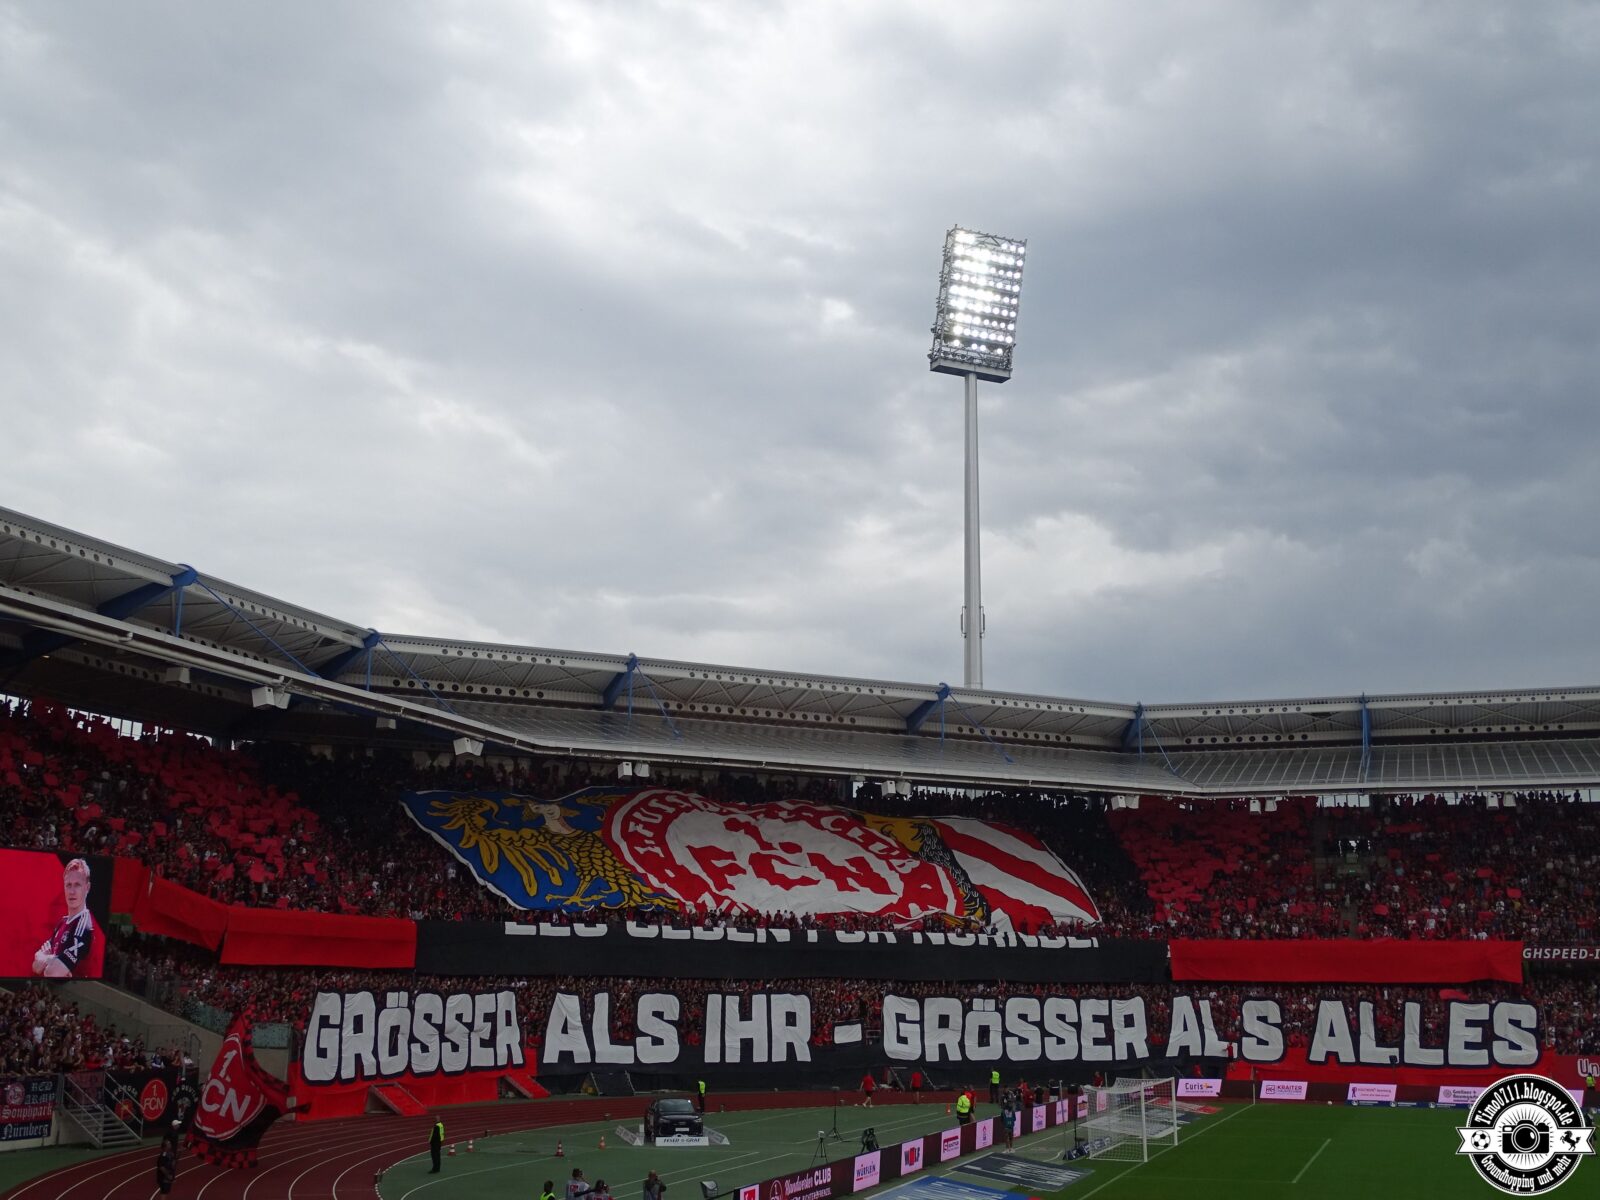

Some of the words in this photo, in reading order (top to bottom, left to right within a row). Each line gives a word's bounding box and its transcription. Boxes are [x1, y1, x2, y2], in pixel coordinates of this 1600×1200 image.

[686, 844, 898, 896] FCN
[303, 990, 524, 1081] GRÖSSER
[543, 991, 680, 1064] ALS
[704, 993, 812, 1064] IHR
[833, 1023, 862, 1044] -
[882, 993, 1149, 1062] GRÖSSER
[1165, 995, 1285, 1062] ALS
[1309, 1000, 1540, 1066] ALLES
[1185, 1082, 1203, 1090] Curis
[143, 1098, 164, 1112] FCN
[814, 1167, 832, 1187] CLUB
